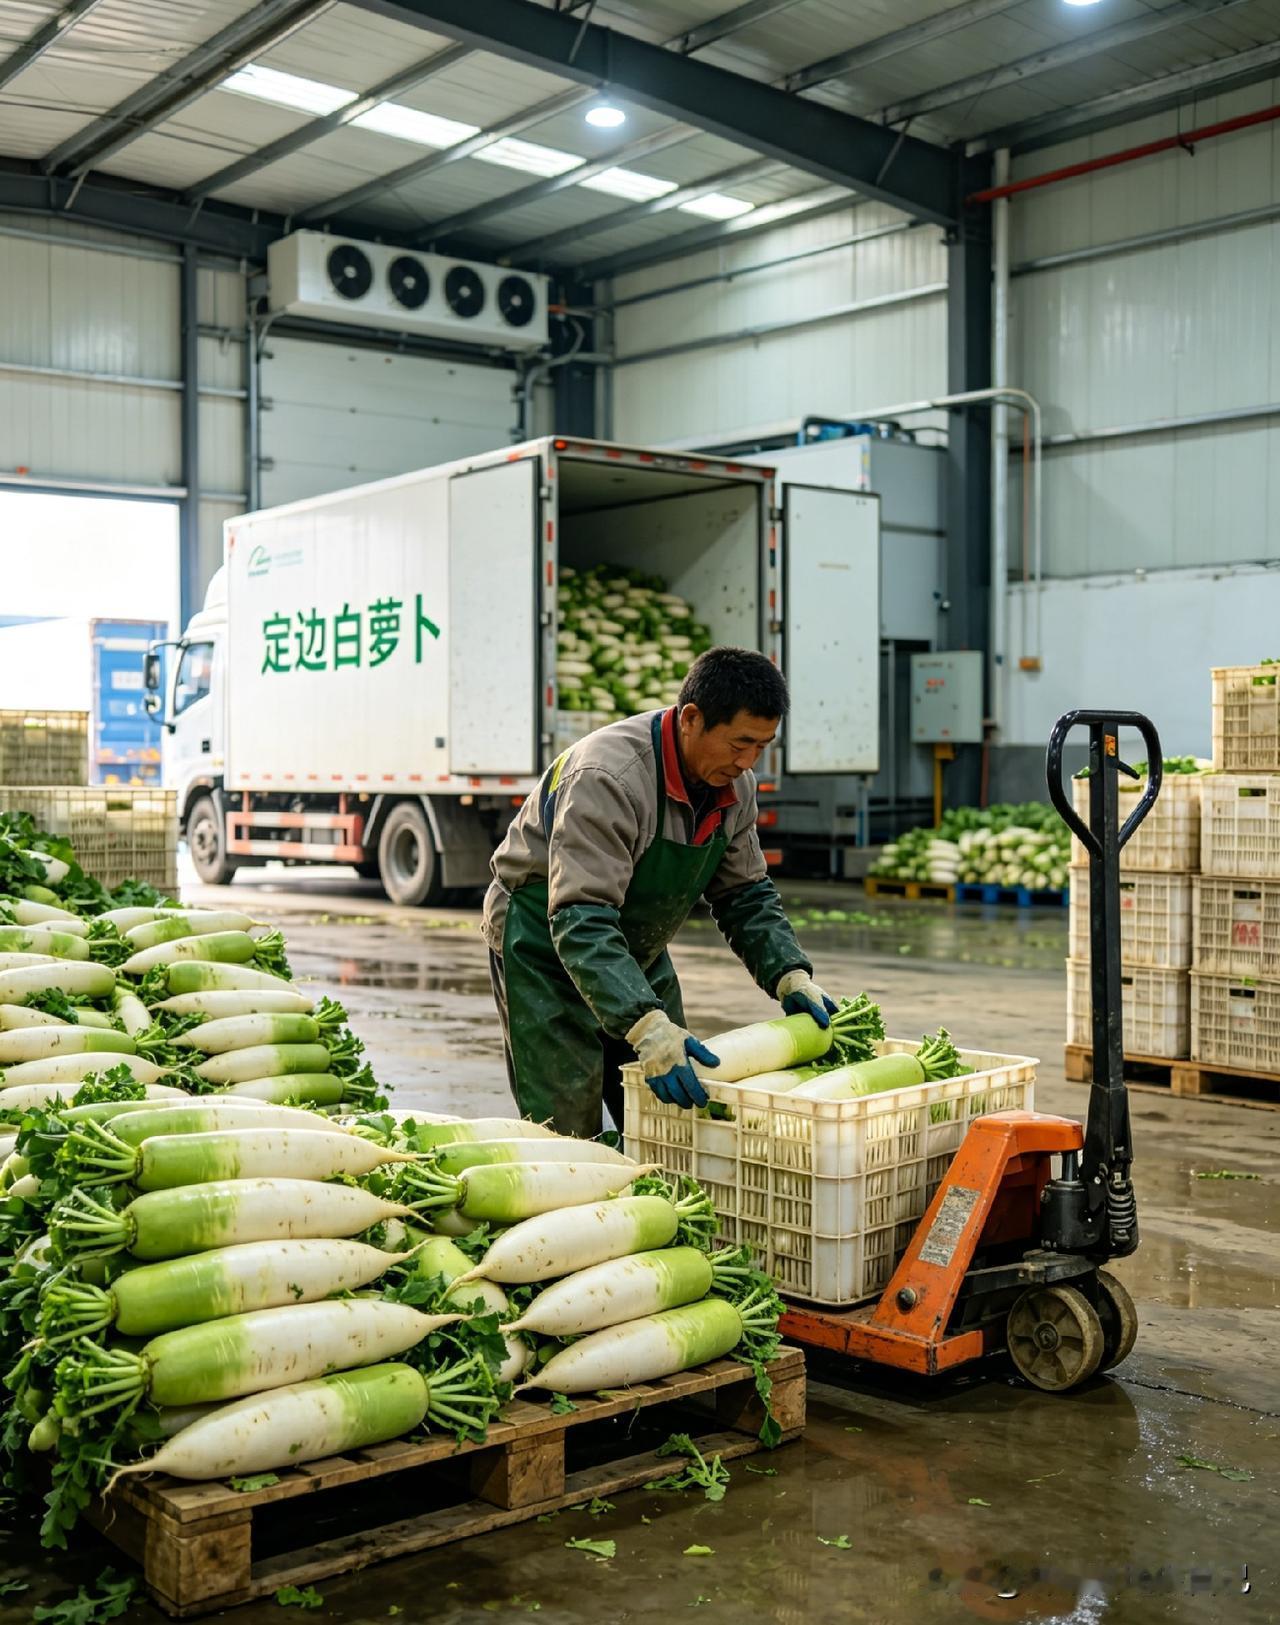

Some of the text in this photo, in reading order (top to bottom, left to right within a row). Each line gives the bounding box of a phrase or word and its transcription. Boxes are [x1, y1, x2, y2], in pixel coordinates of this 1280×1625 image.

[261, 593, 441, 675] 定边白萝卜
